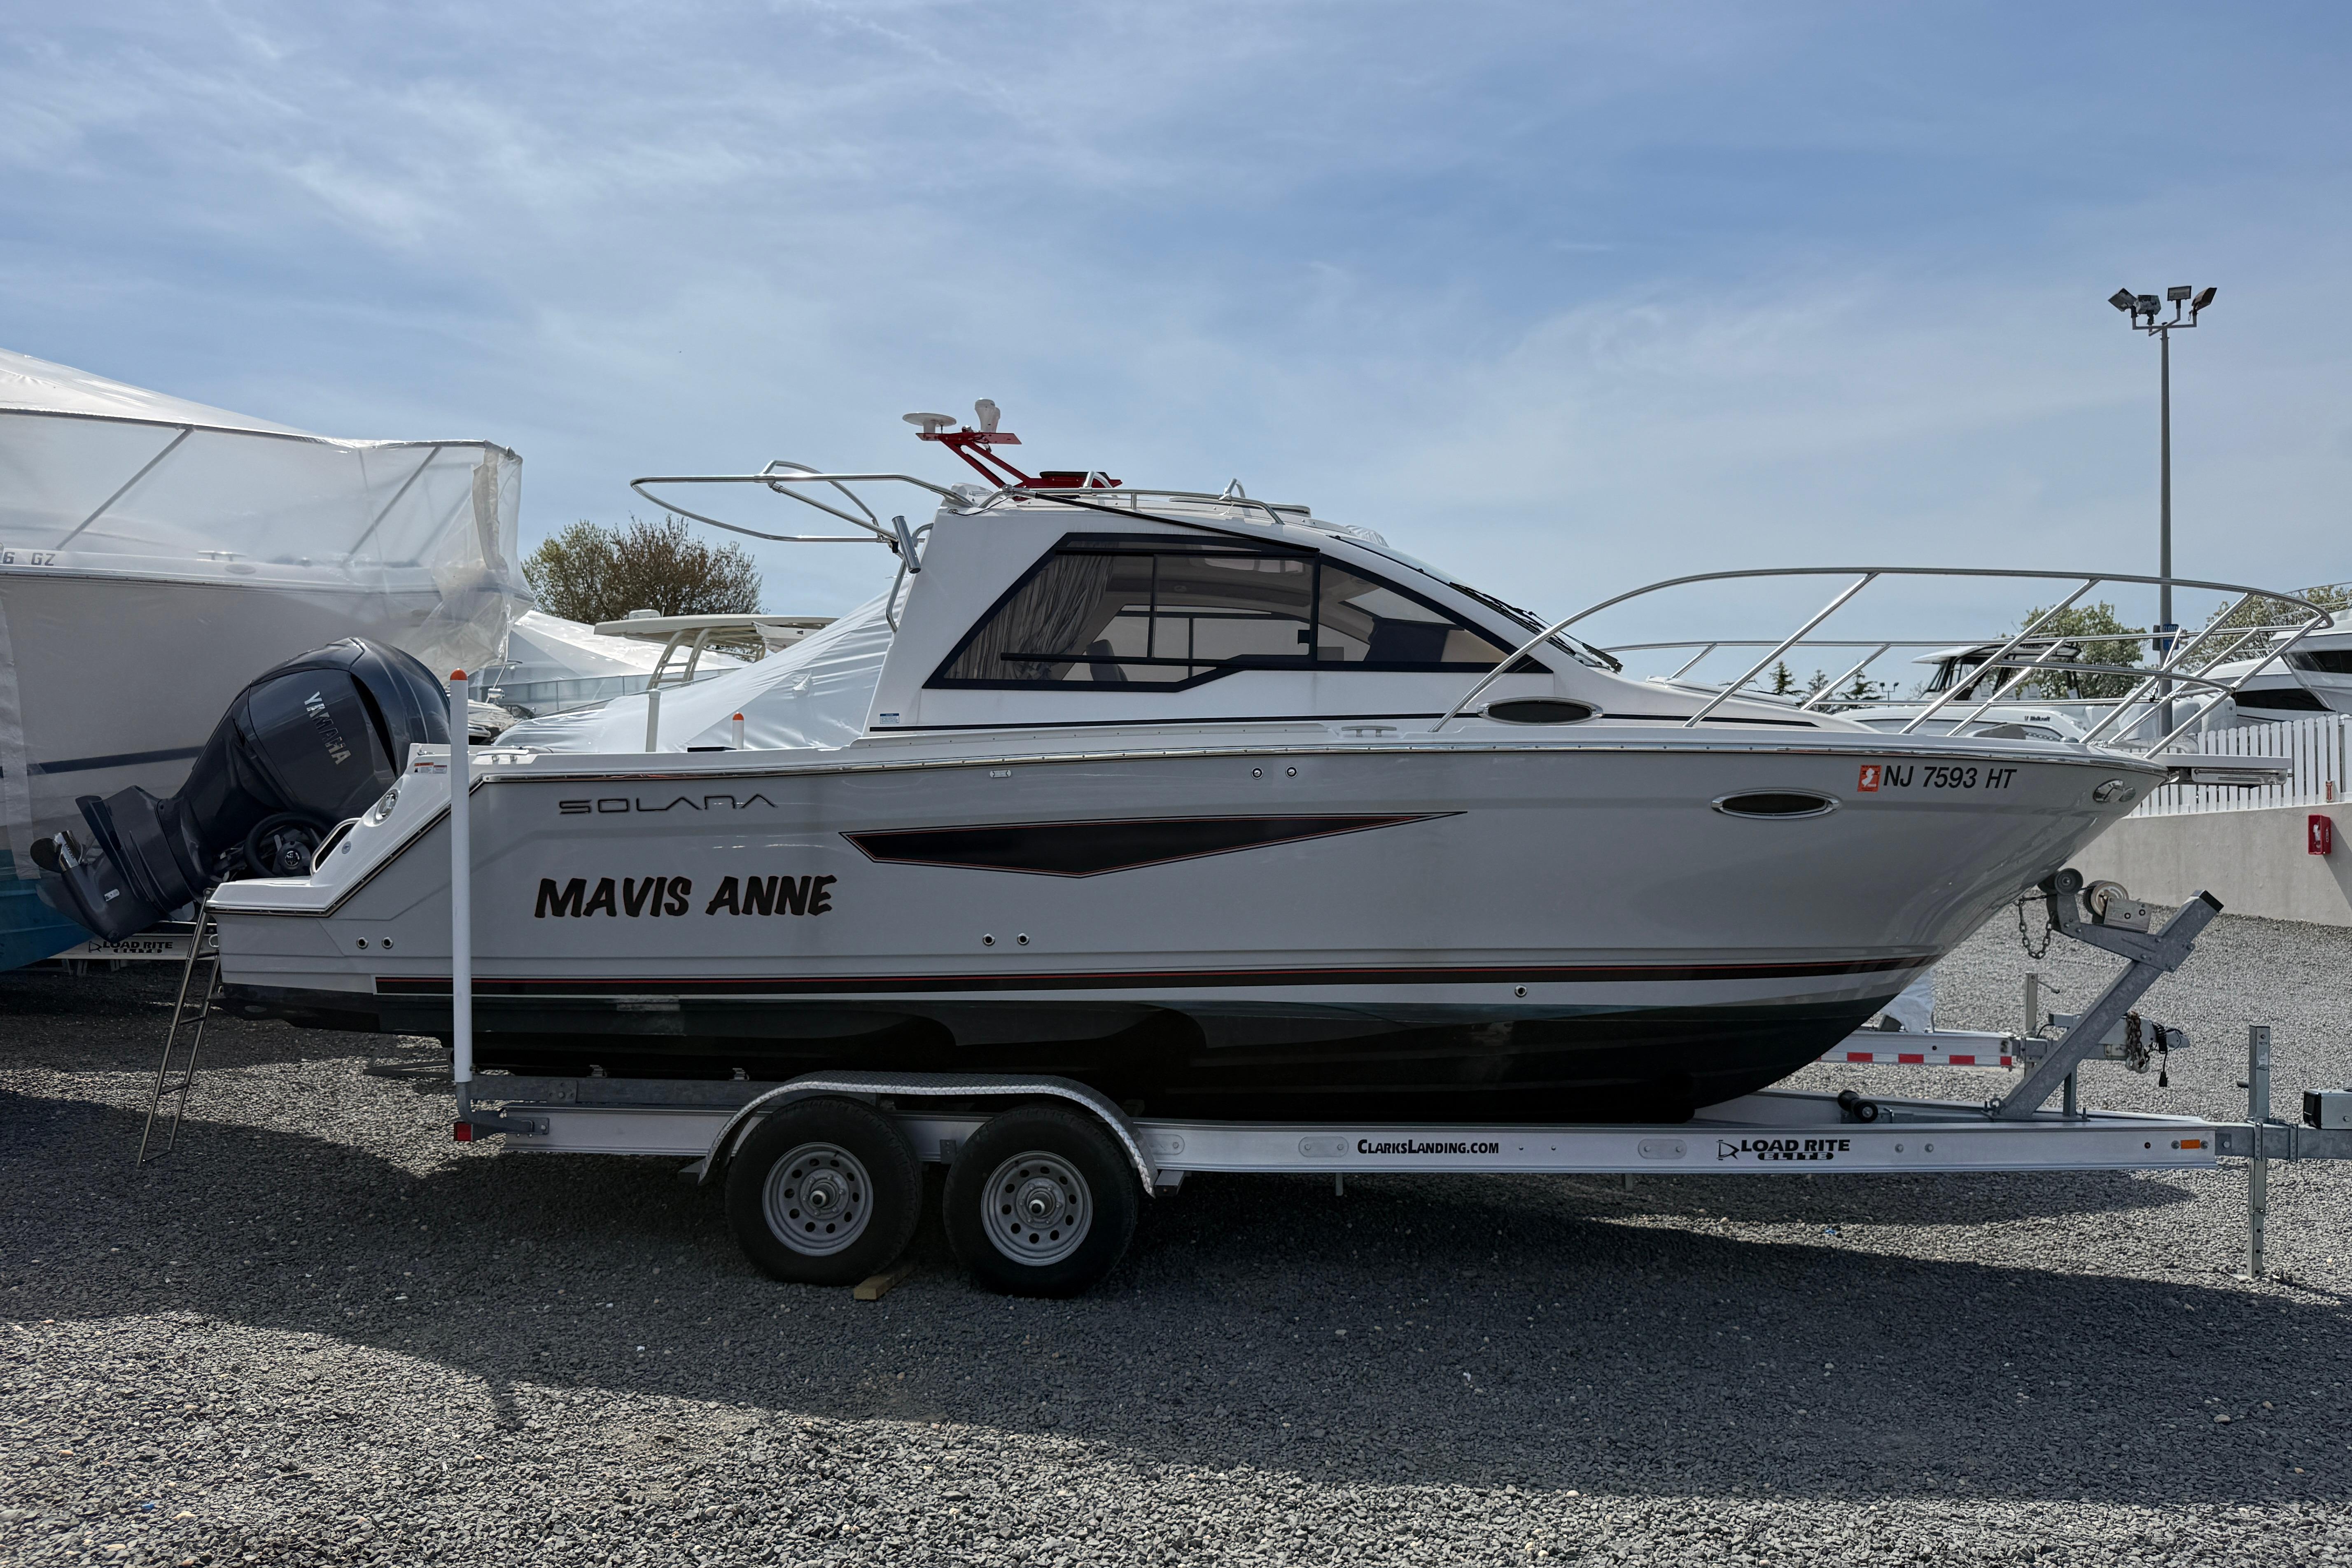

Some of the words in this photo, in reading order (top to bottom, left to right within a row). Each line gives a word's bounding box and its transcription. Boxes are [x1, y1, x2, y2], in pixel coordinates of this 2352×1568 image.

[31, 553, 56, 566] GZ
[304, 691, 351, 765] YAMAHA
[1883, 765, 1914, 787] NJ
[1923, 766, 1977, 789] 7593
[1985, 768, 2017, 789] HT
[559, 794, 778, 814] SOLARA
[535, 876, 692, 918] MAVIS
[705, 874, 838, 916] ANNE
[1741, 1139, 1799, 1152] LOAD
[1804, 1139, 1850, 1152] RITE
